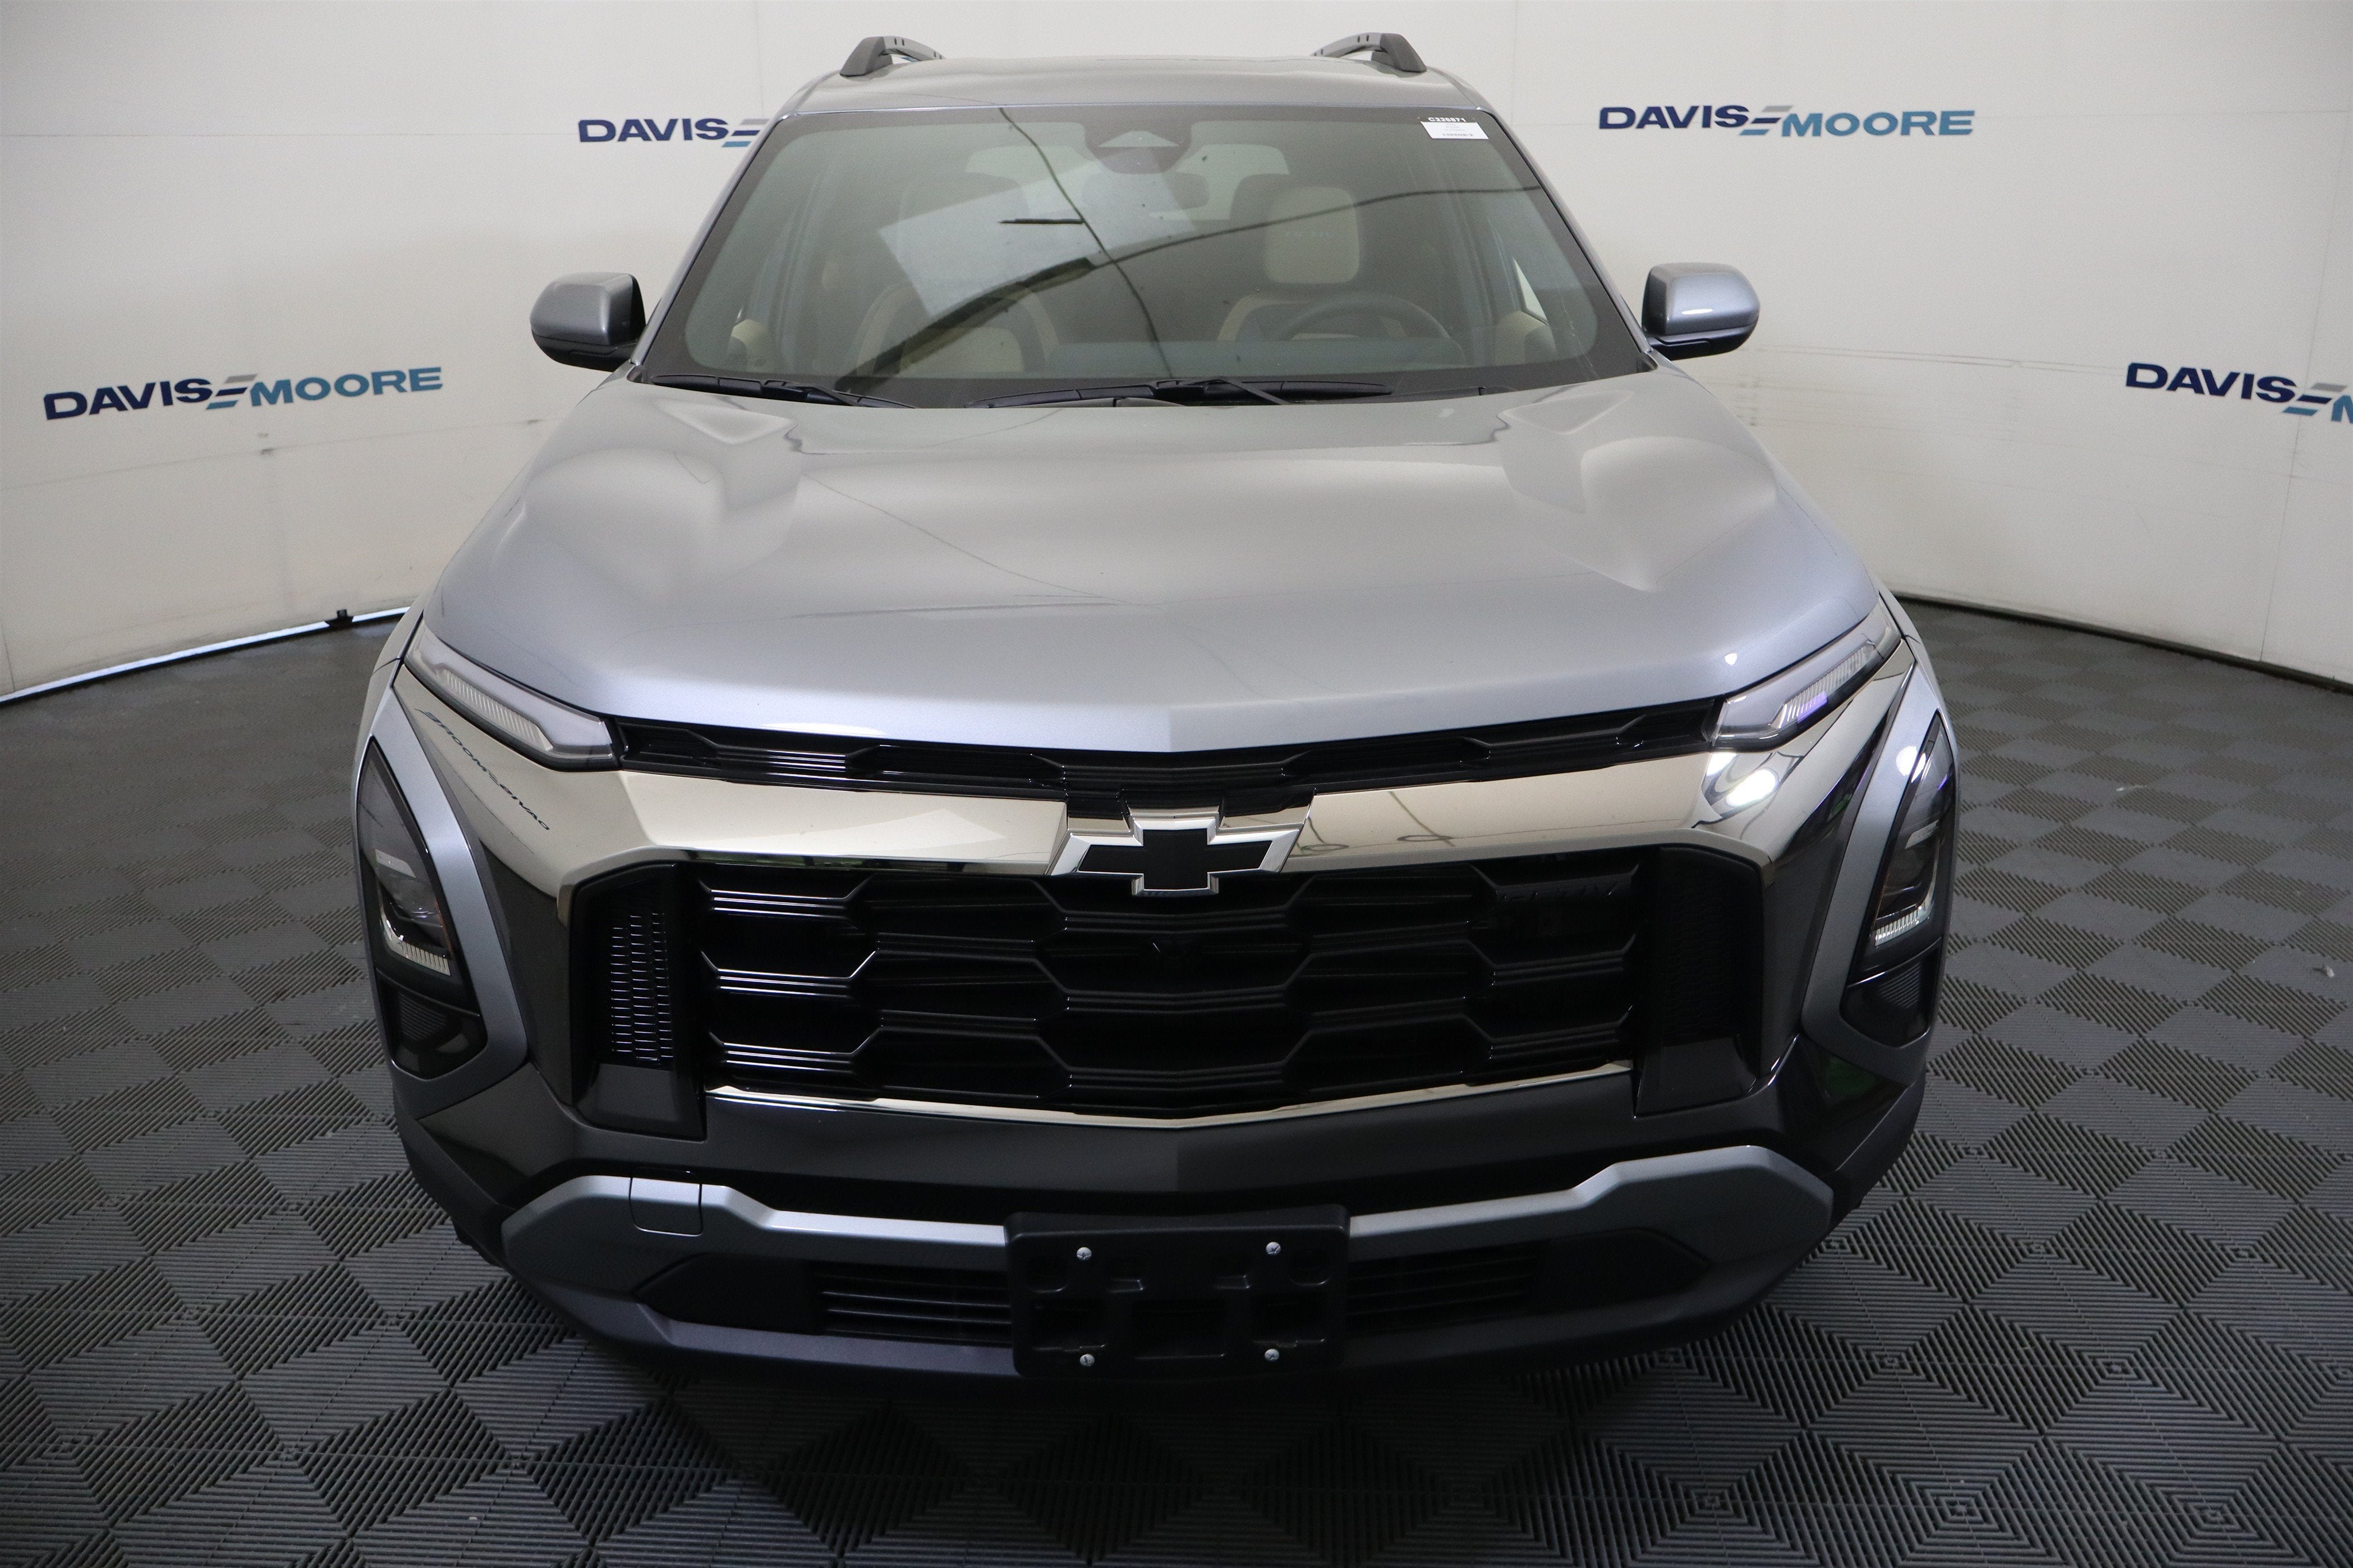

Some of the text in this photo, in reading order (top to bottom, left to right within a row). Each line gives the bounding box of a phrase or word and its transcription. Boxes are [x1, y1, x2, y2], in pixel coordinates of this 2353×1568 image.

[578, 118, 728, 142] DAVIS
[1599, 105, 1974, 137] DAVIS MOORE
[43, 367, 443, 420] DAVIS MOORE
[2126, 362, 2297, 403] DAVIS
